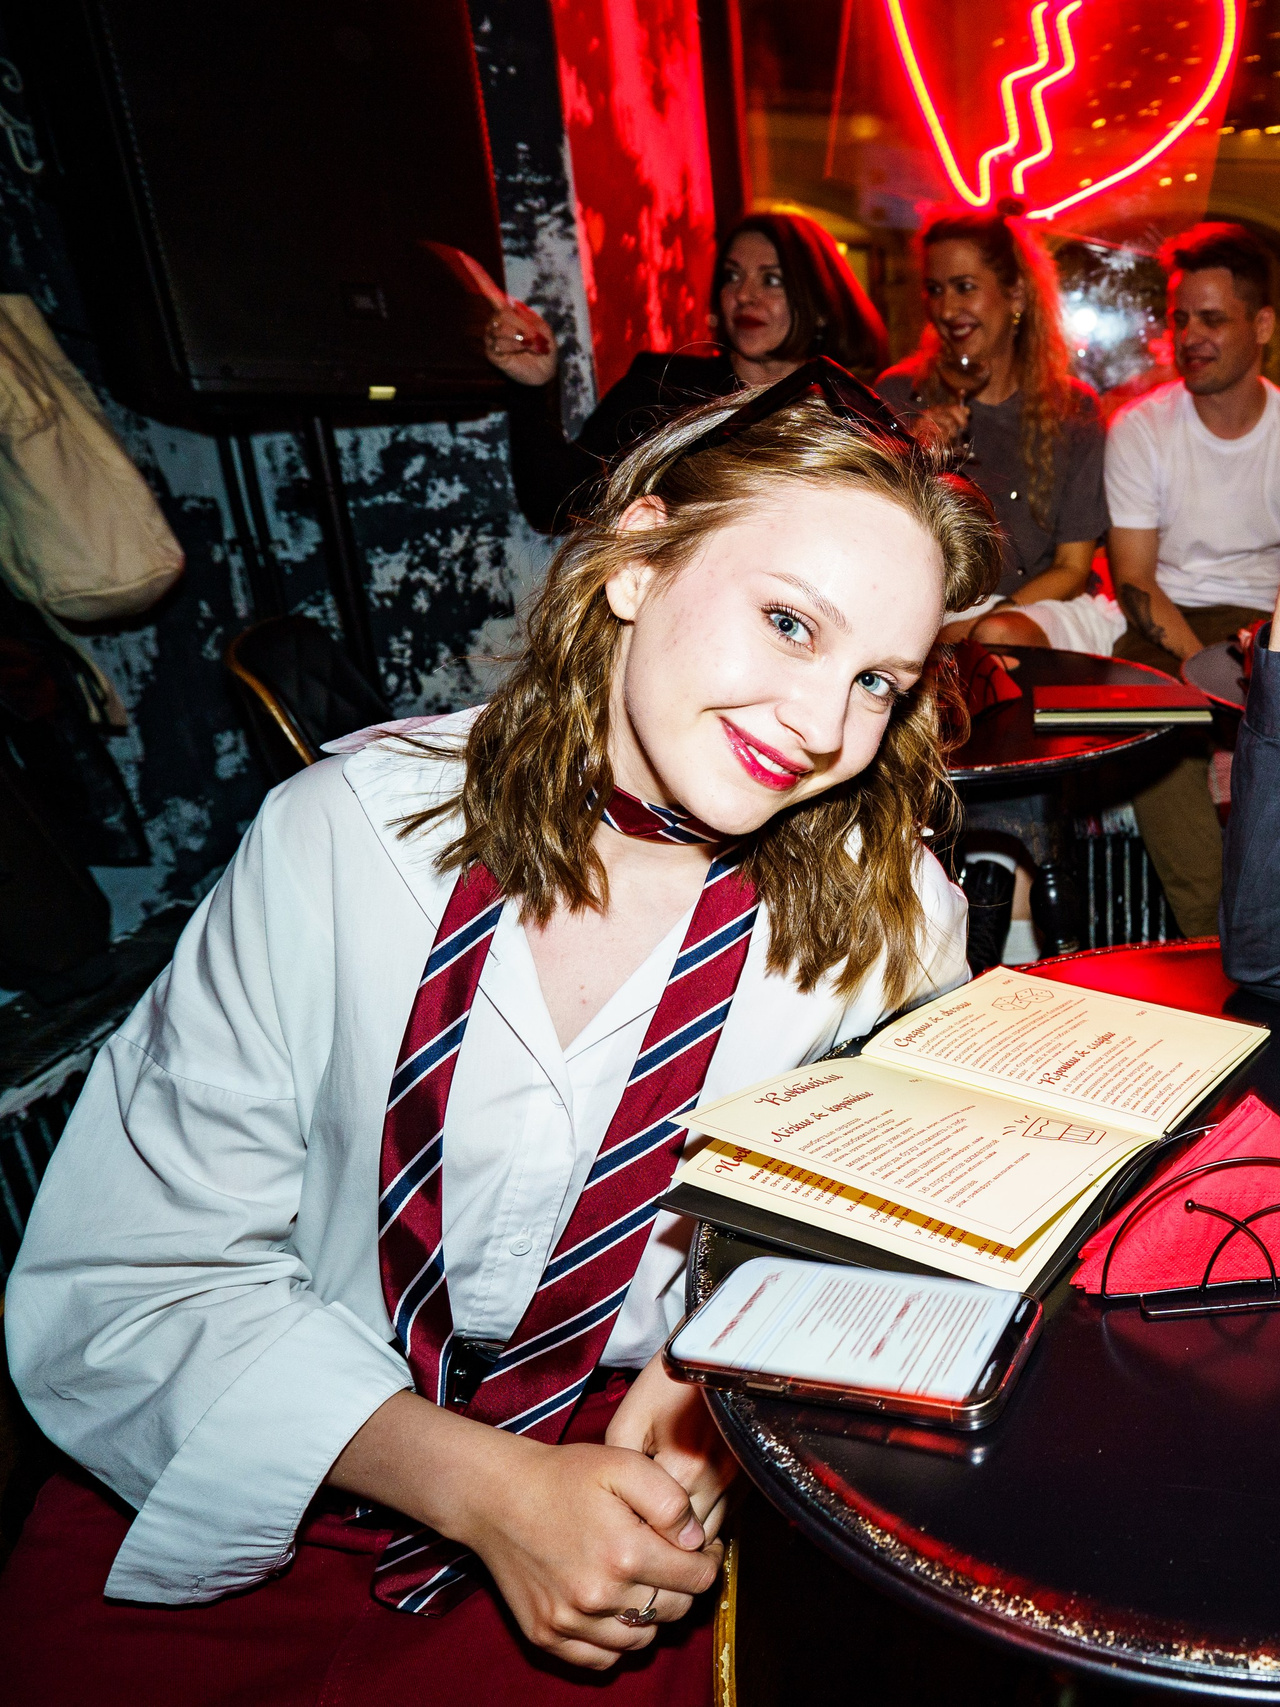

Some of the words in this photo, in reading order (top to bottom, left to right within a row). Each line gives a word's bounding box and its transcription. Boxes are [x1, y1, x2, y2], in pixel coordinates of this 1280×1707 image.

[894, 1022, 931, 1046] Средние
[1037, 1056, 1079, 1084] Крепкие
[754, 1074, 842, 1104] Коктейли
[771, 1118, 813, 1142] Лёгкие
[824, 1091, 872, 1111] короткие
[928, 1162, 964, 1186] портретов
[963, 1139, 998, 1162] ахматовой
[944, 1180, 977, 1202] казанова
